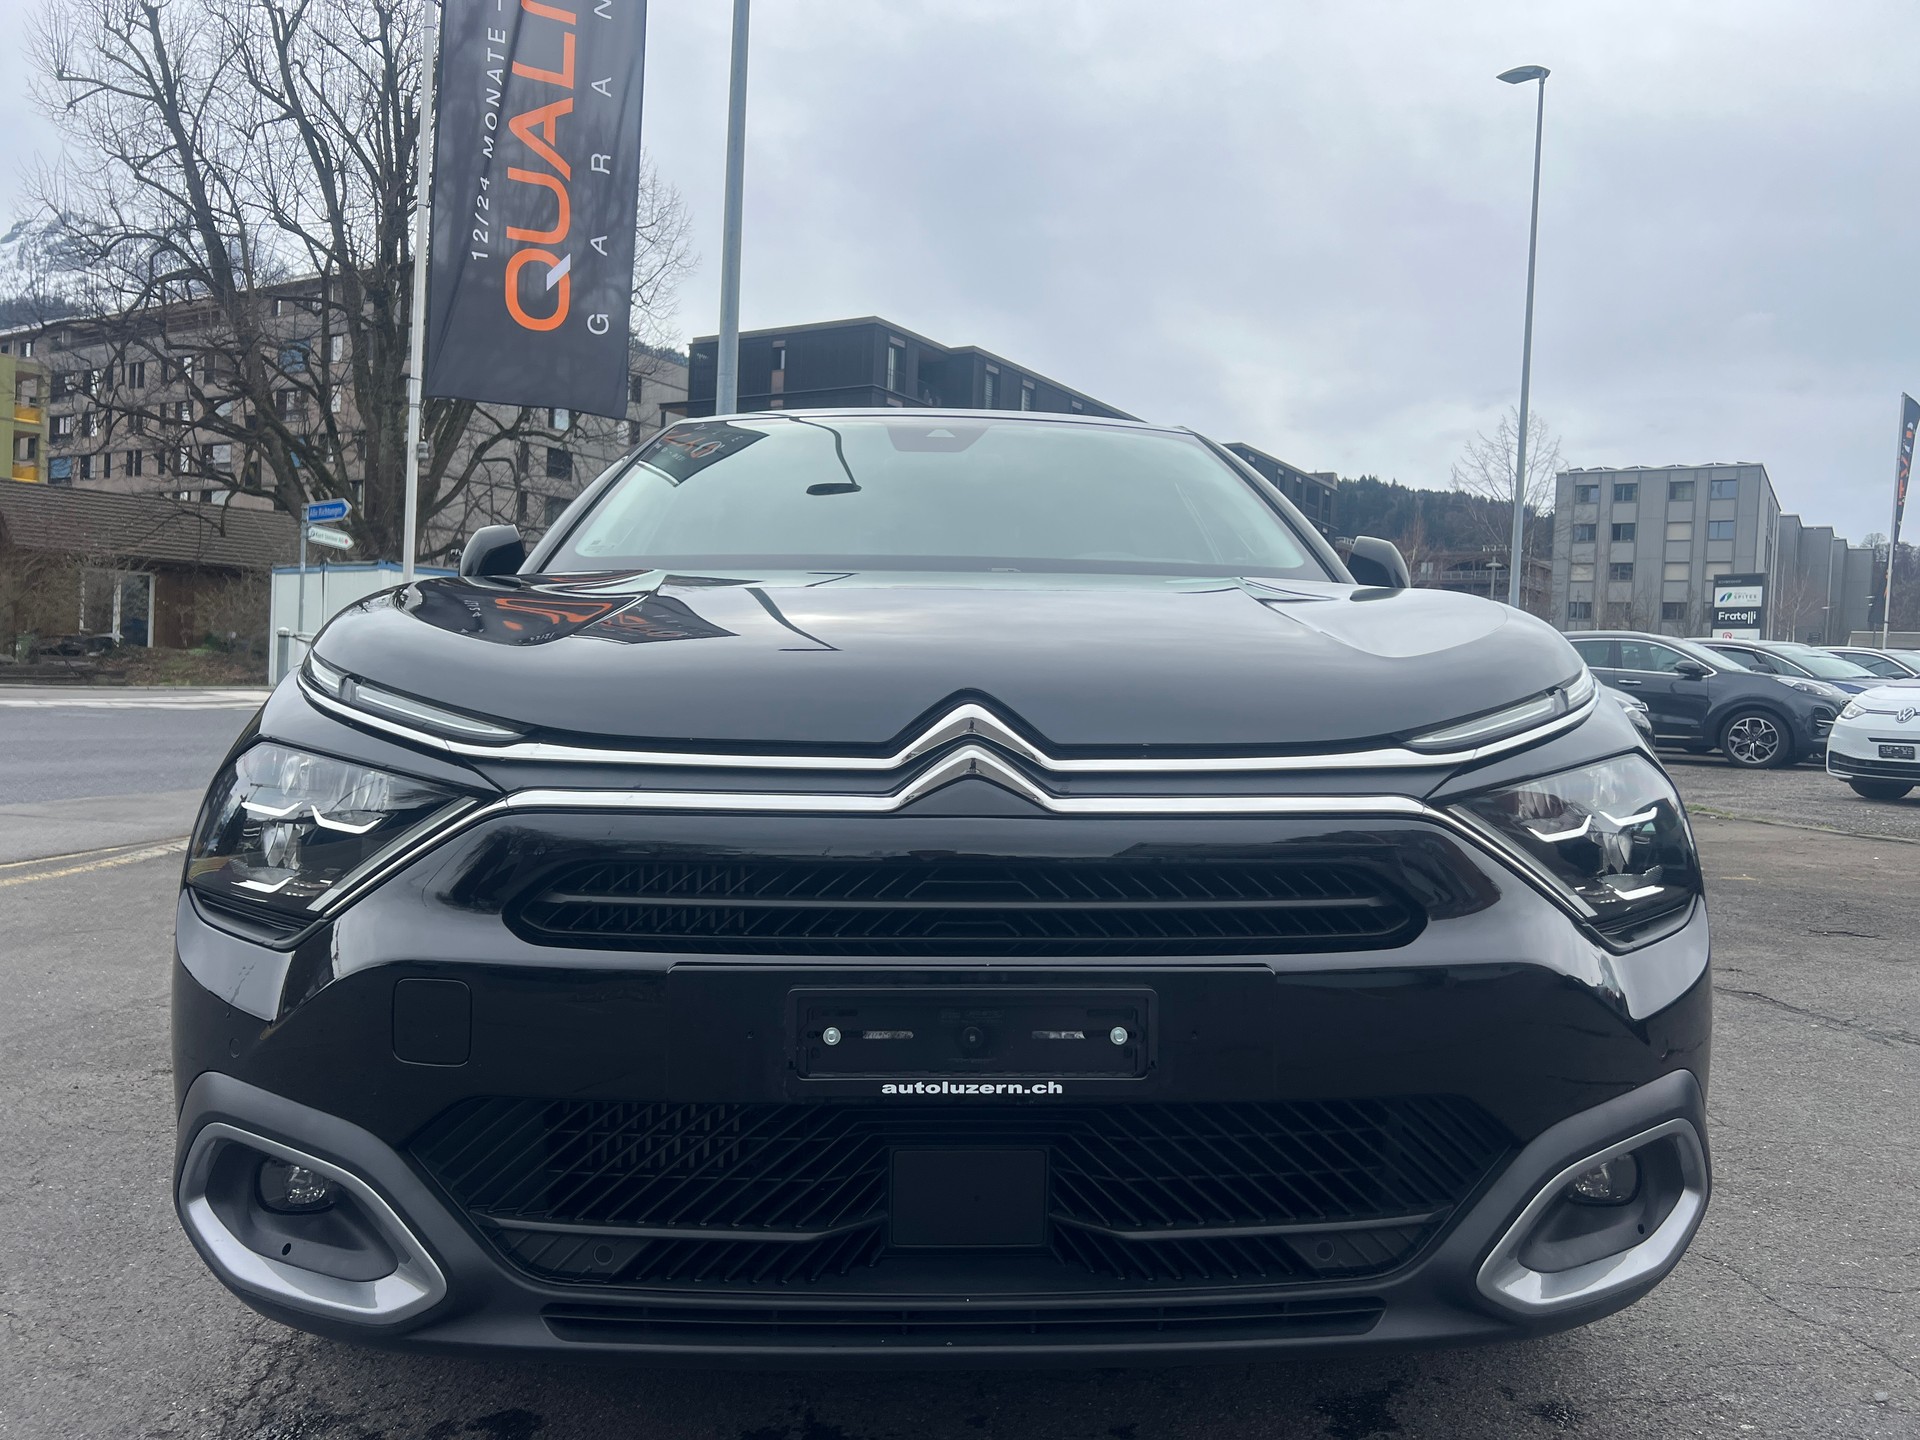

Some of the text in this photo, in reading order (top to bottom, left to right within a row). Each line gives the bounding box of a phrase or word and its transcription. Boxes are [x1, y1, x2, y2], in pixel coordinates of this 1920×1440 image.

[472, 178, 491, 260] 12/24
[483, 26, 506, 159] MONATE
[1718, 611, 1757, 625] Fratelli
[881, 1081, 1064, 1095] autoluzern.ch
